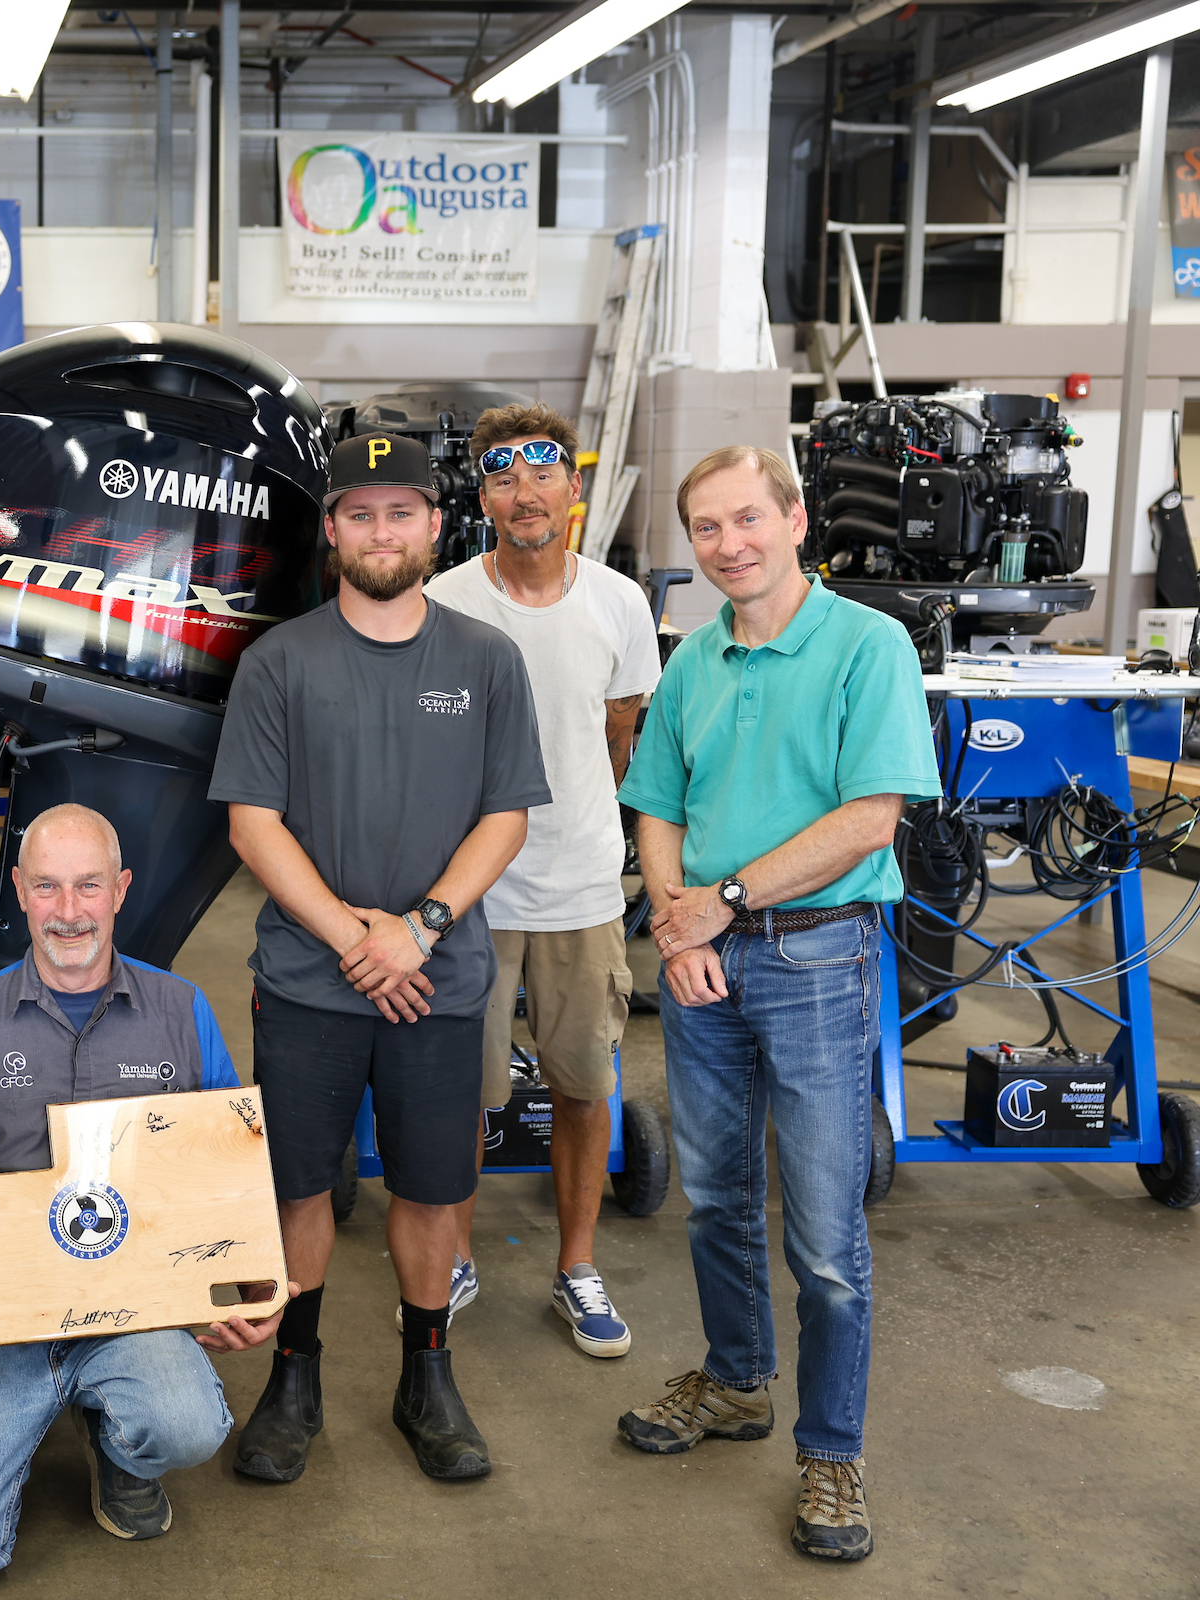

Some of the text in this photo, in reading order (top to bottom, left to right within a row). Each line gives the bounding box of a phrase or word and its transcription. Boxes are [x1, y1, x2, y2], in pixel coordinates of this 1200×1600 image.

[302, 243, 347, 262] Buy!
[359, 244, 405, 262] Sell!
[368, 438, 392, 469] P
[142, 465, 270, 520] YAMAHA
[419, 698, 470, 710] OCEAN ISLE
[426, 707, 463, 715] MARINA
[980, 729, 1008, 741] K&L
[117, 1063, 158, 1074] Yamaha
[0, 1075, 34, 1089] CFCC
[1061, 1093, 1105, 1103] MARINE
